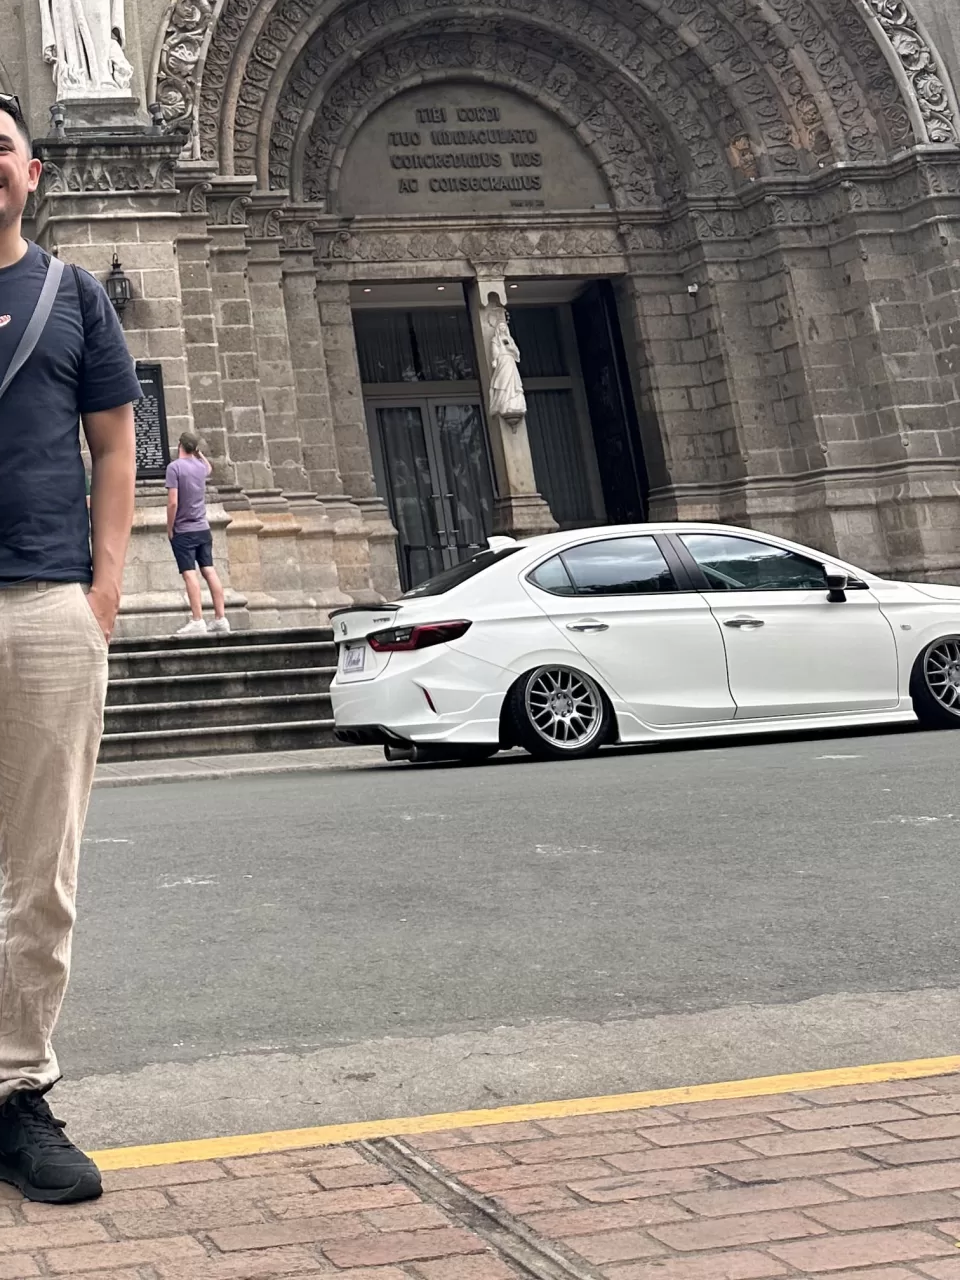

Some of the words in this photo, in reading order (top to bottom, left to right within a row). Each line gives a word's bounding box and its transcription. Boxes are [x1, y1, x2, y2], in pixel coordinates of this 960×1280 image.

[416, 107, 447, 123] TIBI
[388, 131, 421, 147] TUO
[398, 178, 419, 193] AC
